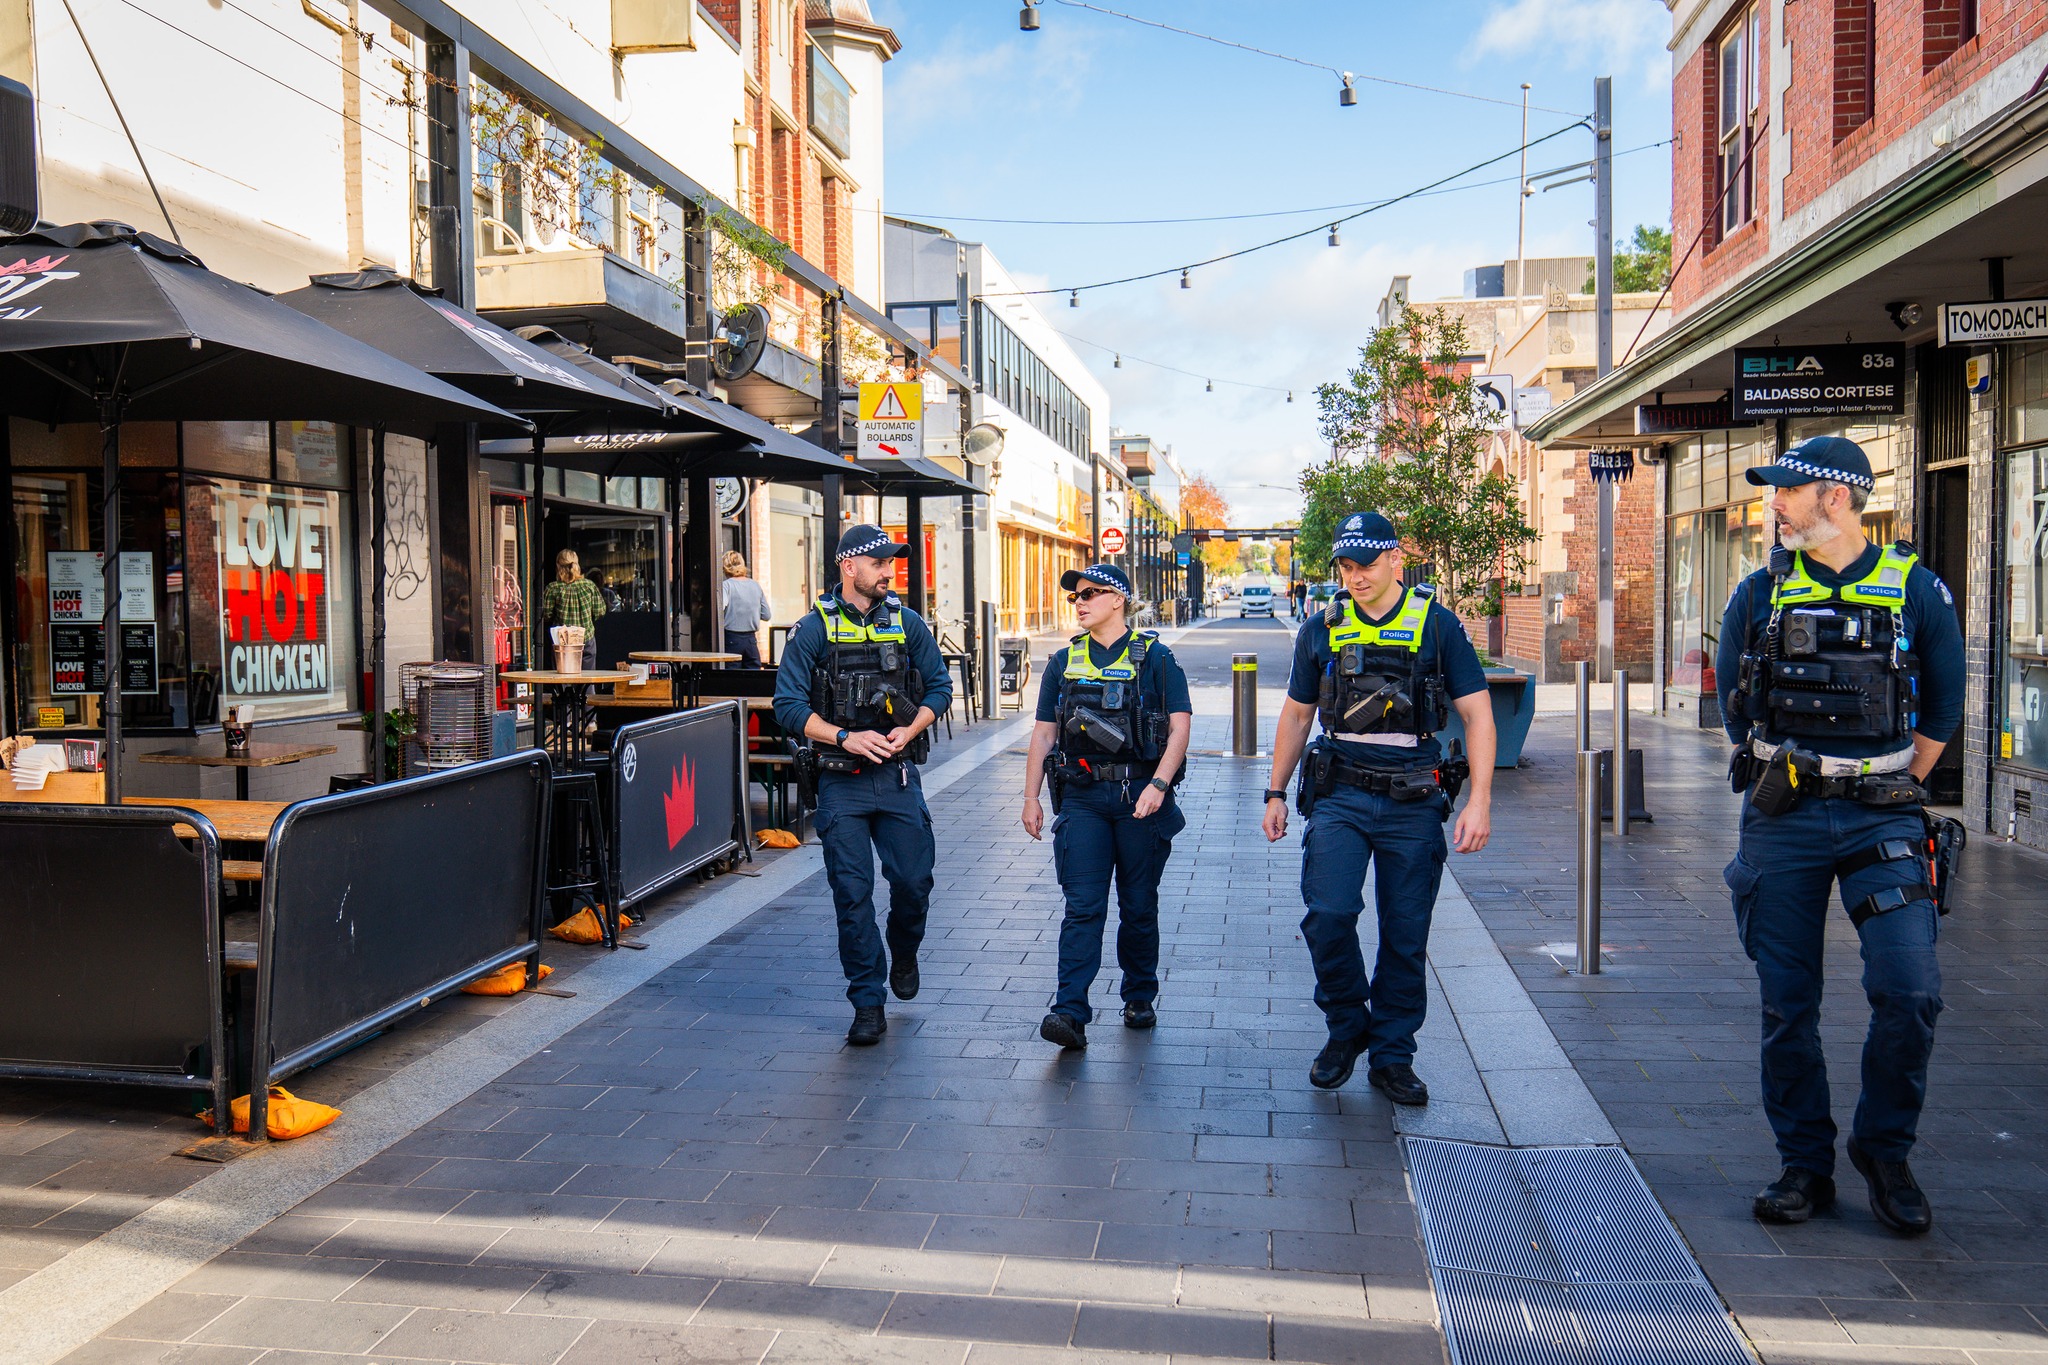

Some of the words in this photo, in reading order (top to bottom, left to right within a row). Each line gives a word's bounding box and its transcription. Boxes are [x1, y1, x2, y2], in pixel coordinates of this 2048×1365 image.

[1950, 305, 2047, 333] TOMODACH
[1743, 356, 1824, 373] BHA
[1862, 354, 1895, 369] 83a
[1744, 388, 1821, 401] BALDASSO
[1824, 385, 1894, 398] CORTESE
[1744, 407, 1783, 415] Architecture
[1813, 406, 1835, 414] Design
[1865, 404, 1893, 412] Planning
[864, 422, 916, 430] AUTOMATIC
[867, 433, 913, 442] BOLLARDS
[583, 441, 640, 450] PROJECT
[1590, 454, 1633, 469] BARBE
[225, 500, 322, 570] LOVE
[53, 590, 82, 600] LOVE
[1860, 586, 1898, 596] Police
[53, 600, 82, 611] HOT
[226, 570, 324, 642] HOT
[53, 611, 83, 619] CHICKEN
[1382, 631, 1411, 639] Police
[55, 661, 85, 672] LOVE
[230, 644, 327, 694] CHICKEN
[55, 671, 85, 683] HOT
[1104, 669, 1128, 677] Police
[56, 682, 86, 691] CHICKEN
